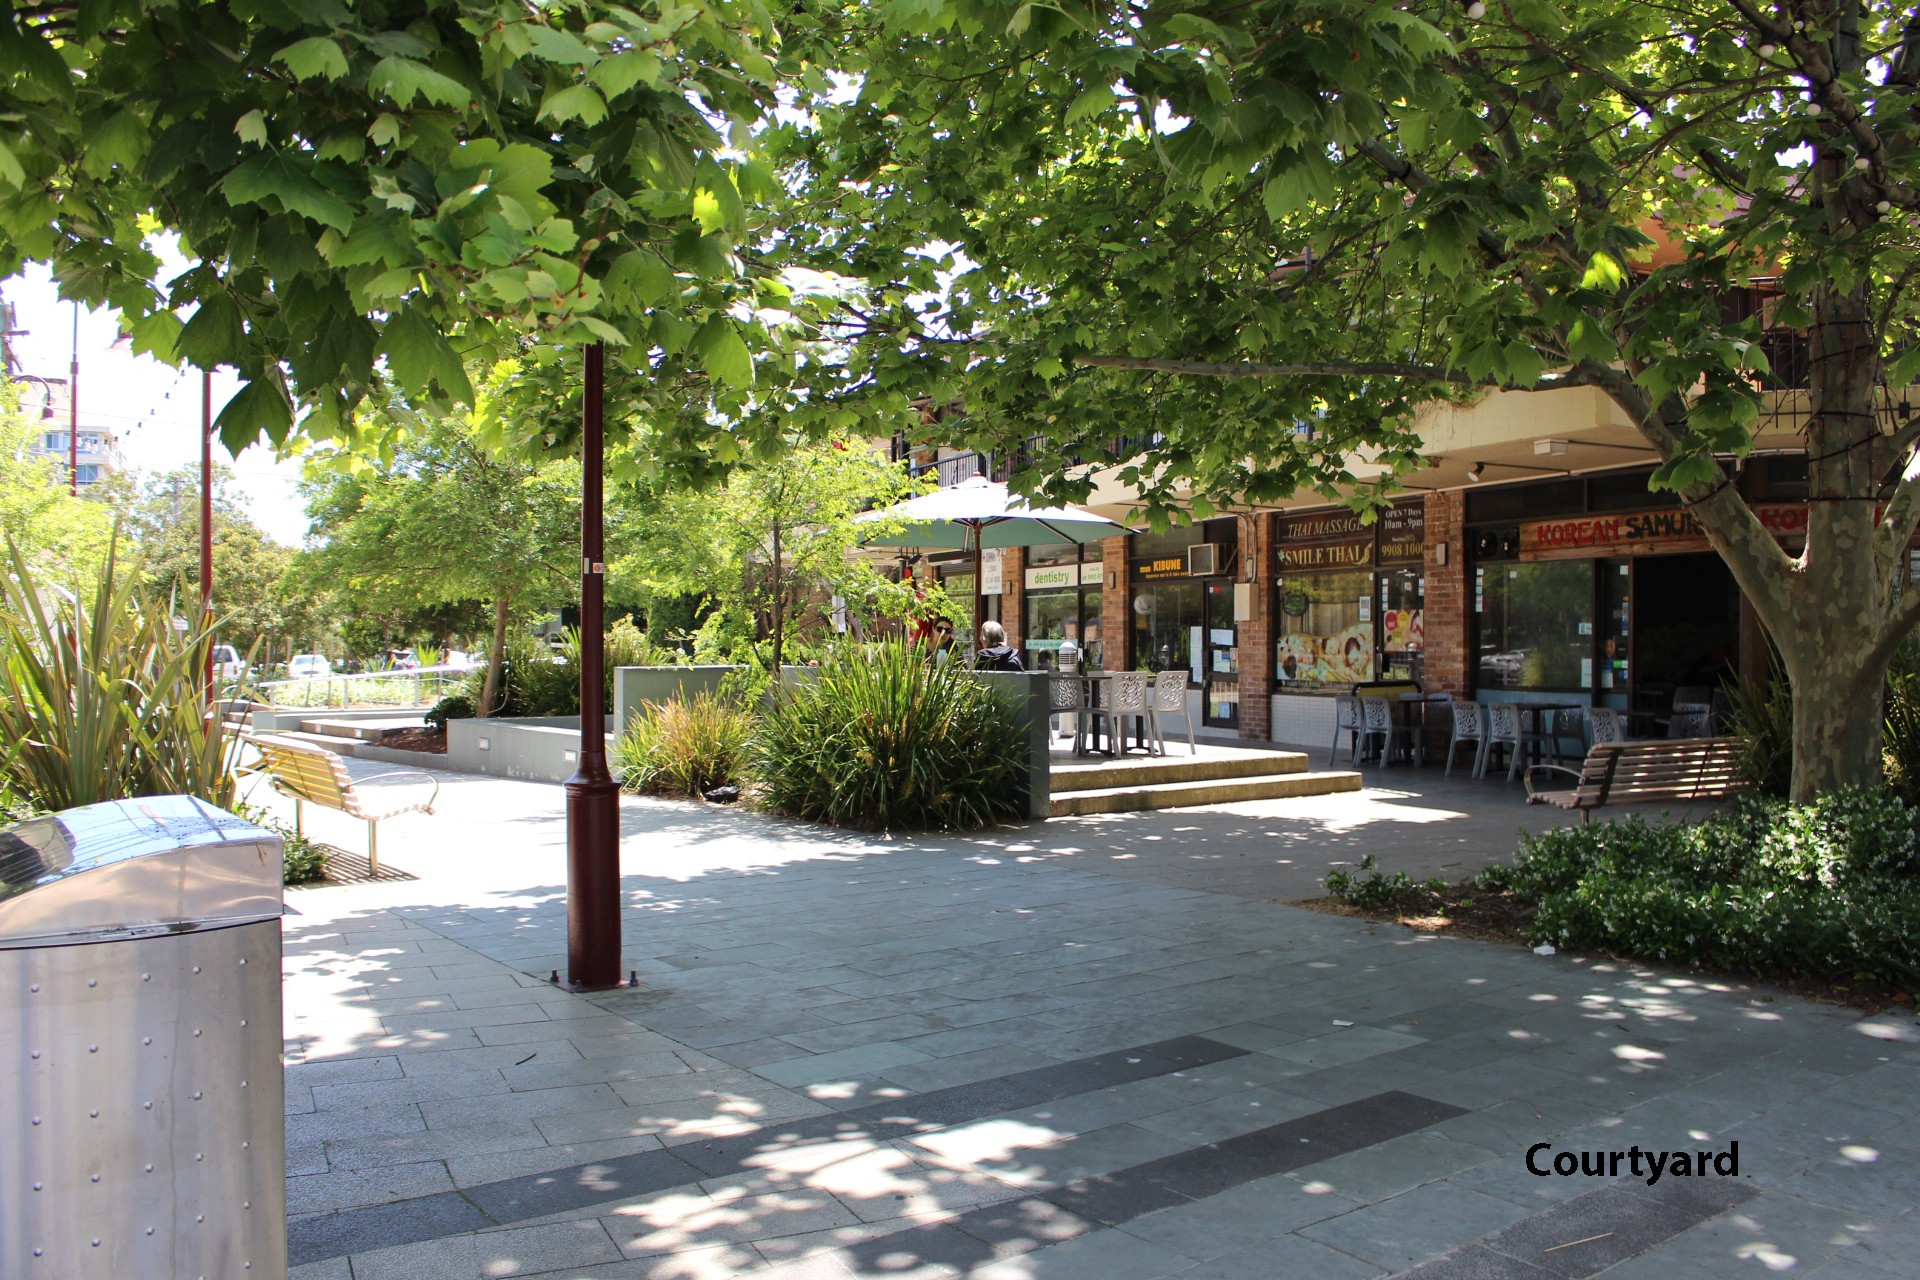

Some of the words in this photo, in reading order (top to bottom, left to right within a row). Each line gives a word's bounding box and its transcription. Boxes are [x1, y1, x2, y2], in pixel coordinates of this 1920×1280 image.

[1385, 509, 1402, 518] OPEN
[1408, 508, 1422, 517] Days
[1288, 521, 1312, 538] THAI
[1313, 517, 1364, 536] MASSAGE
[1384, 519, 1402, 530] 10am
[1407, 517, 1423, 530] 9pm
[1537, 518, 1620, 545] KOREAN
[1285, 547, 1324, 566] SMILE
[1326, 544, 1360, 563] THAI
[1381, 543, 1402, 557] 9908
[1153, 558, 1181, 572] KIBUNE
[1034, 570, 1070, 585] dentistry
